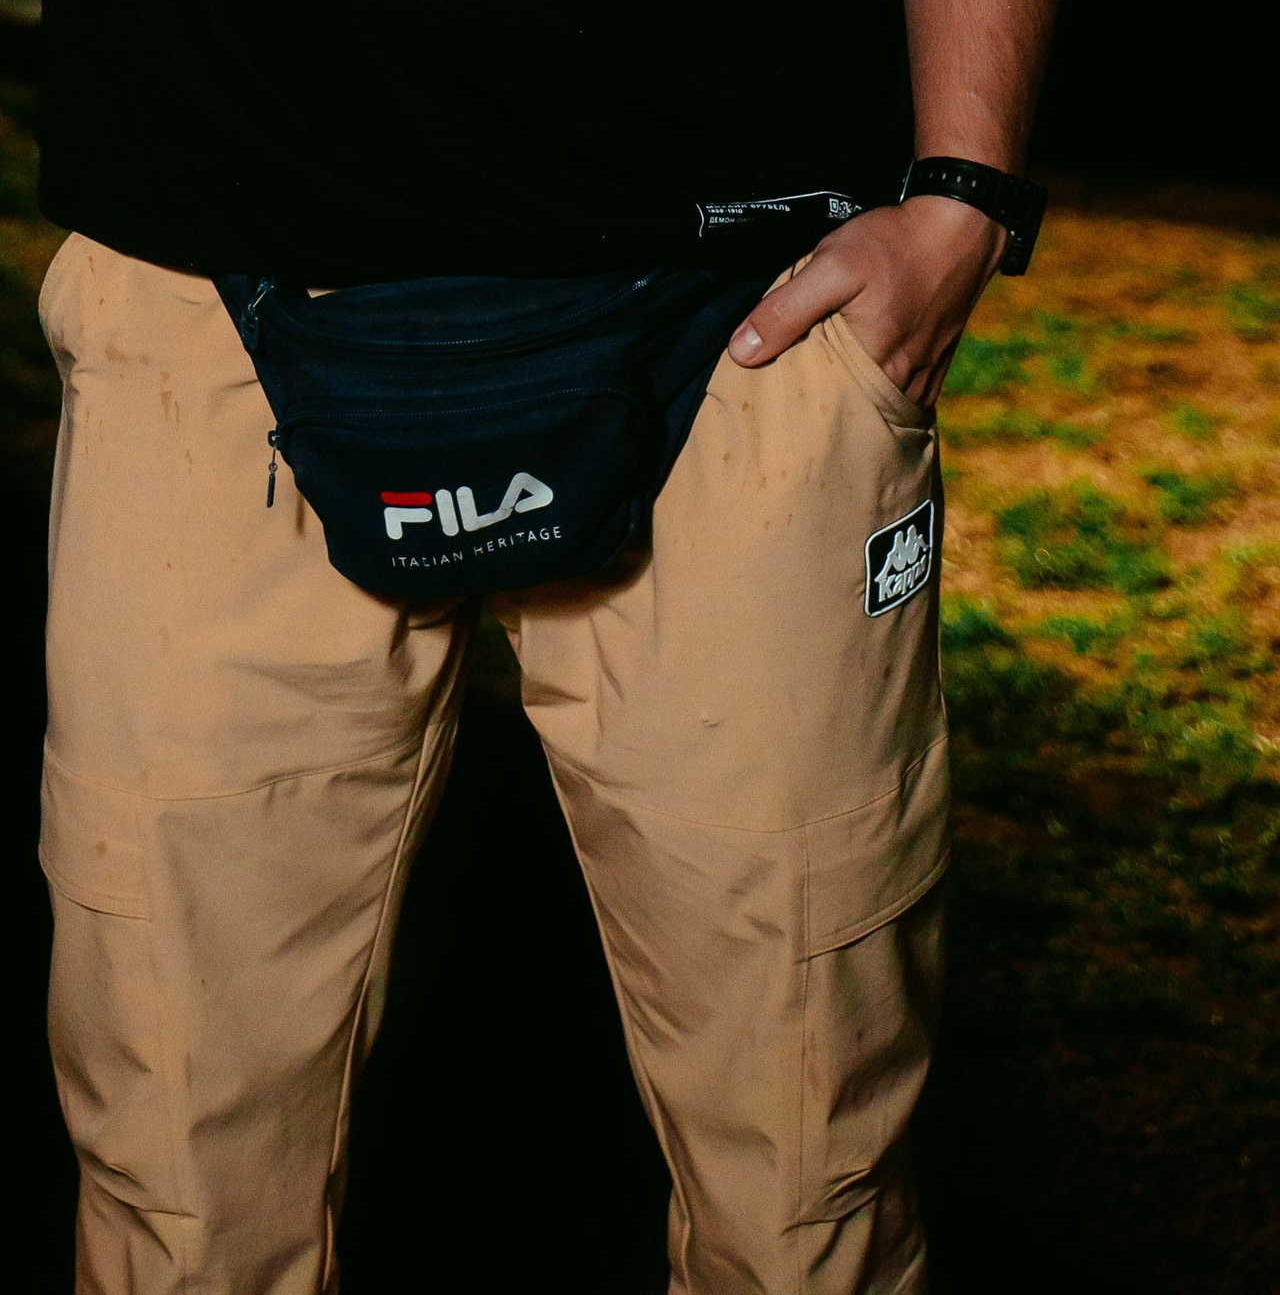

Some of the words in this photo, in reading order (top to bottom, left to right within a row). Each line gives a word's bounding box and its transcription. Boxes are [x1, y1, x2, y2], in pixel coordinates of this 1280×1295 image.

[709, 216, 736, 224] ДЕМОН
[379, 471, 555, 541] FILA
[391, 551, 464, 568] ITALIAN
[473, 525, 563, 557] HERITAGE
